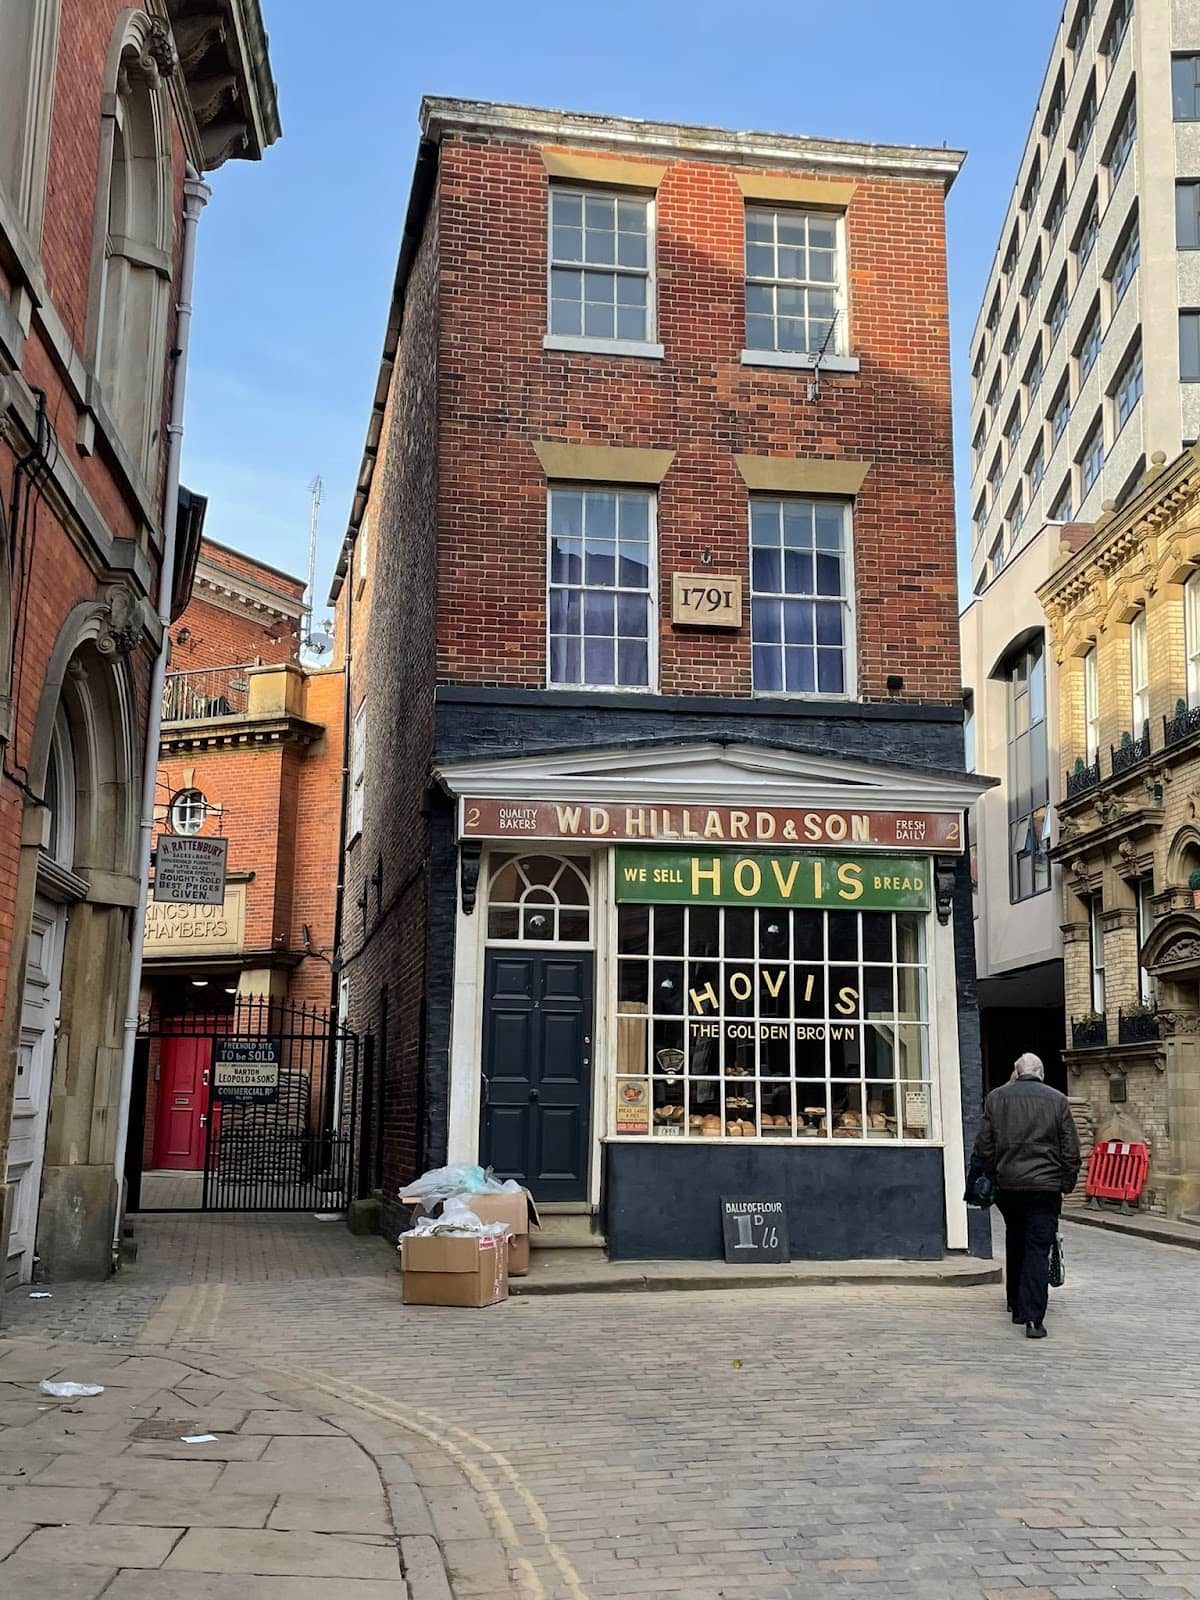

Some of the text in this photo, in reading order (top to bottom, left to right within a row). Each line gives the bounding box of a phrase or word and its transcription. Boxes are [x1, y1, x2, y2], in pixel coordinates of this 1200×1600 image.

[681, 587, 732, 612] 1791
[465, 807, 480, 827] 2
[499, 808, 538, 819] QUALITY
[499, 819, 536, 829] BAKERS
[625, 808, 776, 841] HILLARD
[783, 819, 798, 840] &
[896, 820, 926, 830] FRESH
[896, 830, 926, 841] DAILY
[946, 822, 959, 840] 2
[171, 840, 224, 857] RATTENBURY
[160, 873, 194, 882] BOUGHT
[200, 876, 221, 884] SOLD
[624, 857, 923, 900] WE SELL HOVIS BREAD
[160, 881, 220, 891] BEST PRICES
[144, 921, 228, 939] HAMBERS
[689, 970, 859, 1015] HOVIS
[690, 1024, 854, 1041] THE GOLDEN BROWN
[221, 1050, 234, 1060] TO
[248, 1051, 275, 1061] SOLD
[219, 1073, 250, 1083] LEOPOLD
[257, 1074, 275, 1083] SONS
[218, 1088, 264, 1096] COMMERCIAL
[725, 1203, 746, 1213] BALLS
[757, 1202, 782, 1213] FLOUR
